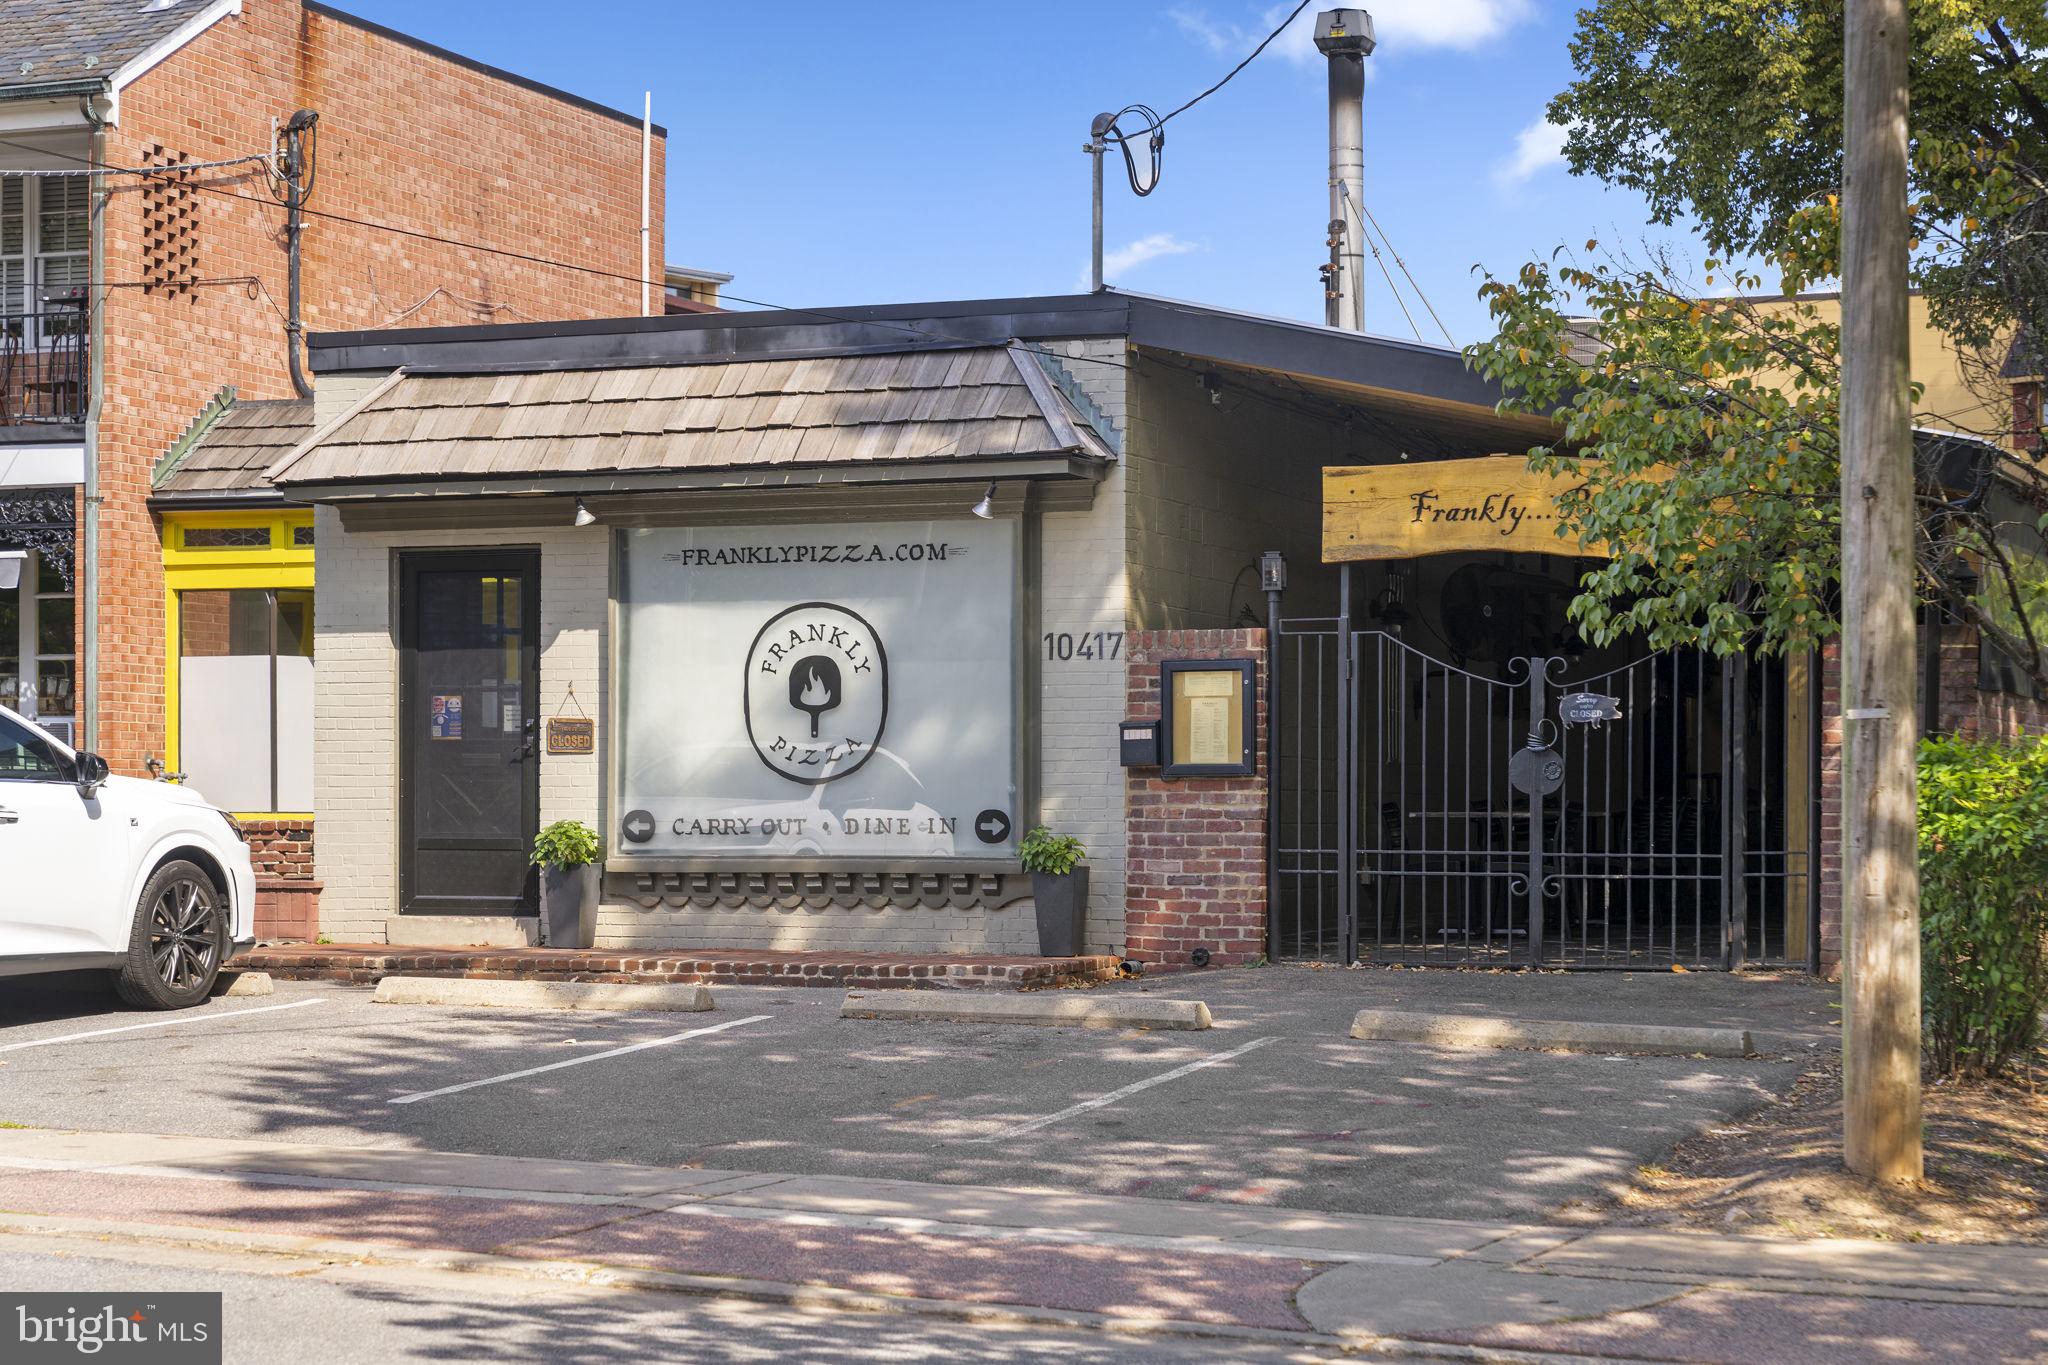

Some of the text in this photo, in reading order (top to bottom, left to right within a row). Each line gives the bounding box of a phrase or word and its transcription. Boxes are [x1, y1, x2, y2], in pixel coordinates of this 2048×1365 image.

[681, 543, 948, 566] FRANKLYPIZZA.COM
[761, 623, 871, 676] FRANKLY
[1043, 631, 1123, 661] 10417
[1570, 709, 1603, 718] CLOSED
[551, 734, 591, 748] CLOSED
[769, 735, 863, 766] PIZZA
[672, 816, 957, 836] CARRY OUT DINE IN
